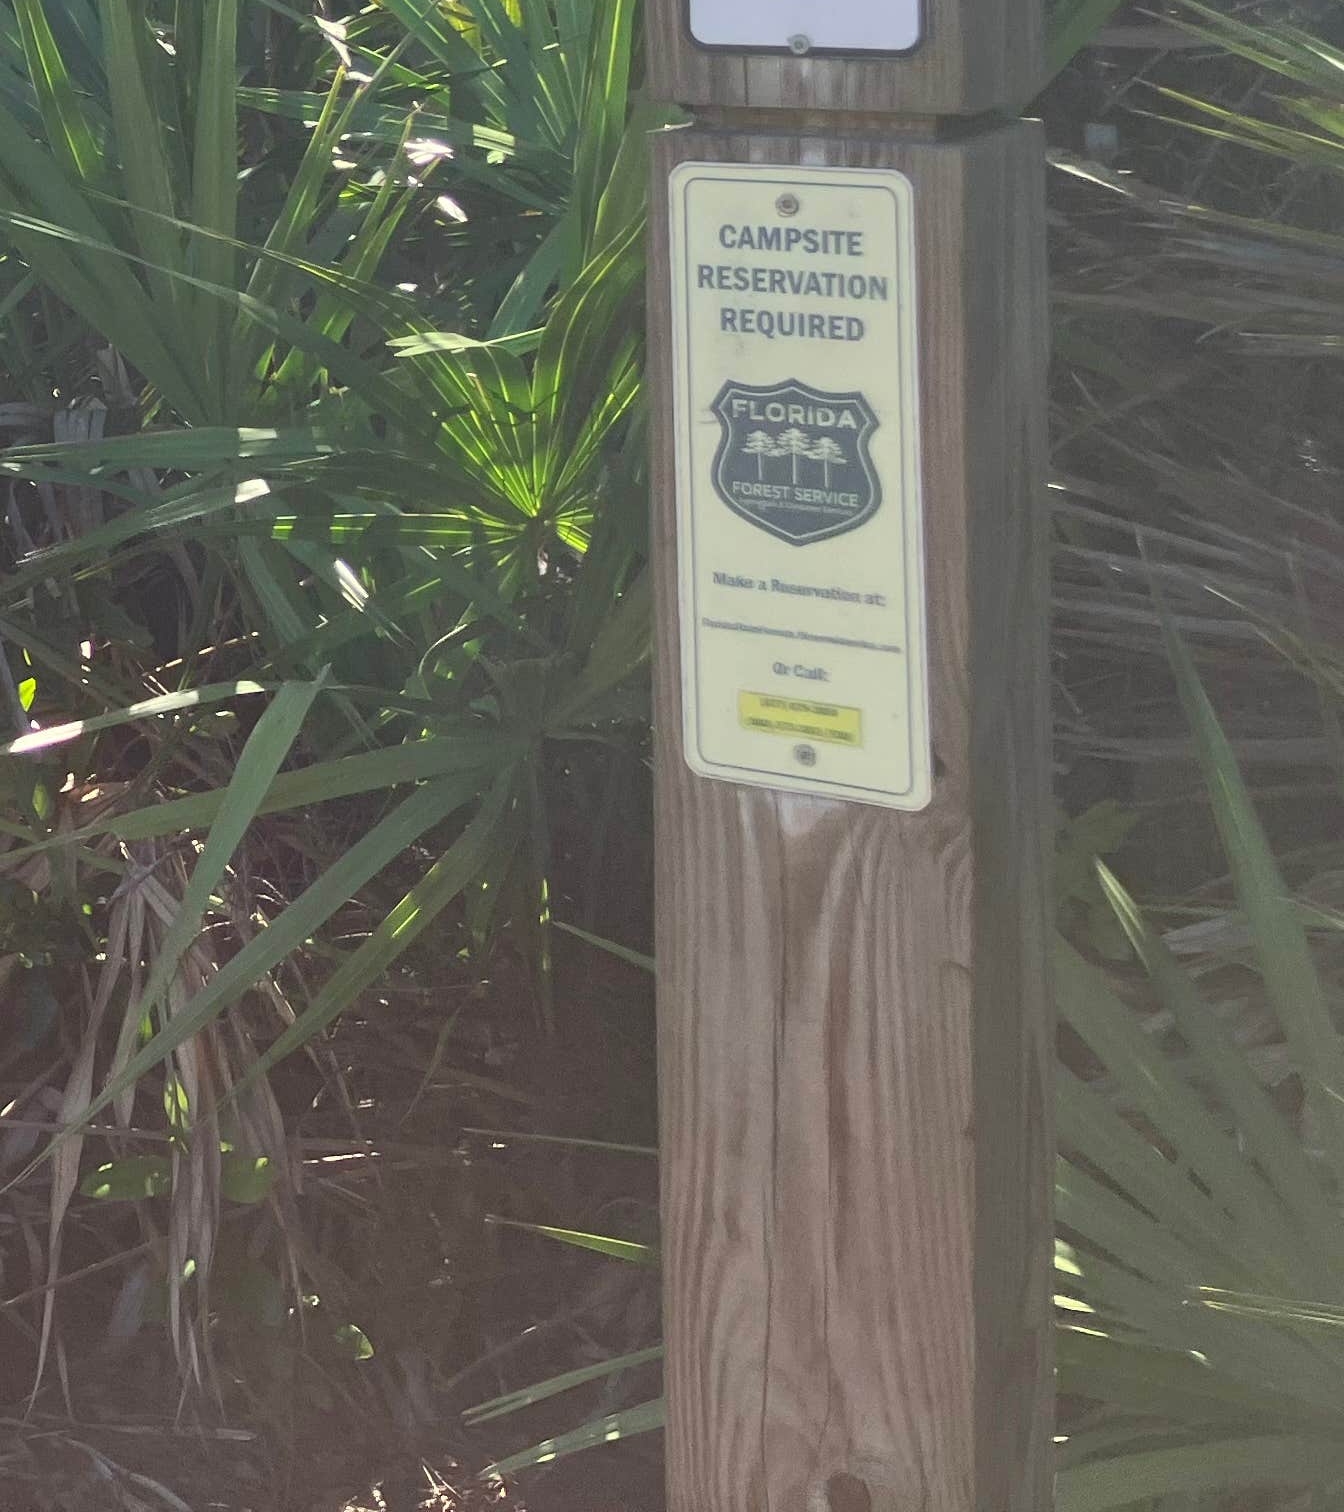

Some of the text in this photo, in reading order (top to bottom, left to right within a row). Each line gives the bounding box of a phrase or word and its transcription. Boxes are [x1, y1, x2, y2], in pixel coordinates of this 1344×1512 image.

[718, 224, 864, 257] CAMPSITE
[697, 264, 888, 301] RESERVATION
[720, 307, 865, 342] REQUIRED
[731, 399, 857, 429] FLORIDA
[732, 481, 859, 507] FOREST SERVICE
[712, 571, 753, 589] Make
[758, 580, 767, 591] a
[771, 579, 861, 604] Reservation
